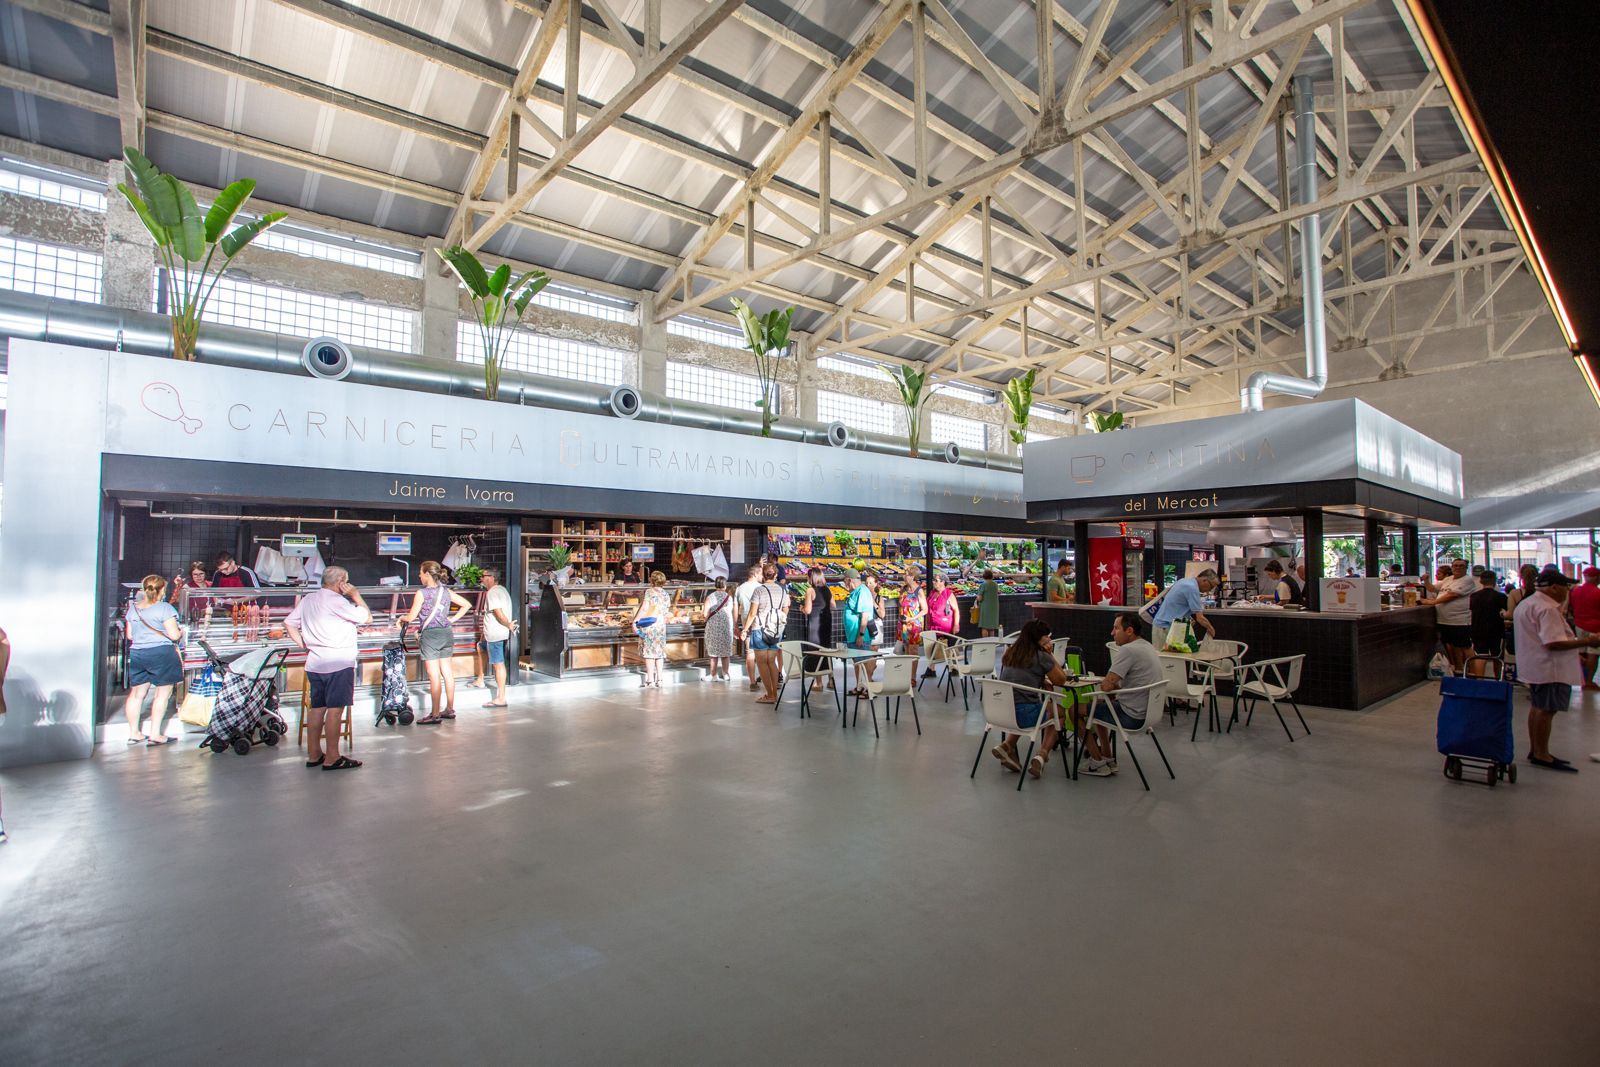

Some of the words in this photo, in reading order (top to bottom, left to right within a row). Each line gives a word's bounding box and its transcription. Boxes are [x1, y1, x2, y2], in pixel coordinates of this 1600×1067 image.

[227, 402, 525, 457] CARNICERIA
[593, 442, 792, 481] ULTRAMARINOS
[1121, 437, 1276, 473] CANTINA
[388, 479, 447, 500] Jaime
[464, 483, 515, 503] Ivorra
[1124, 499, 1147, 512] del
[1157, 493, 1219, 510] Mercat
